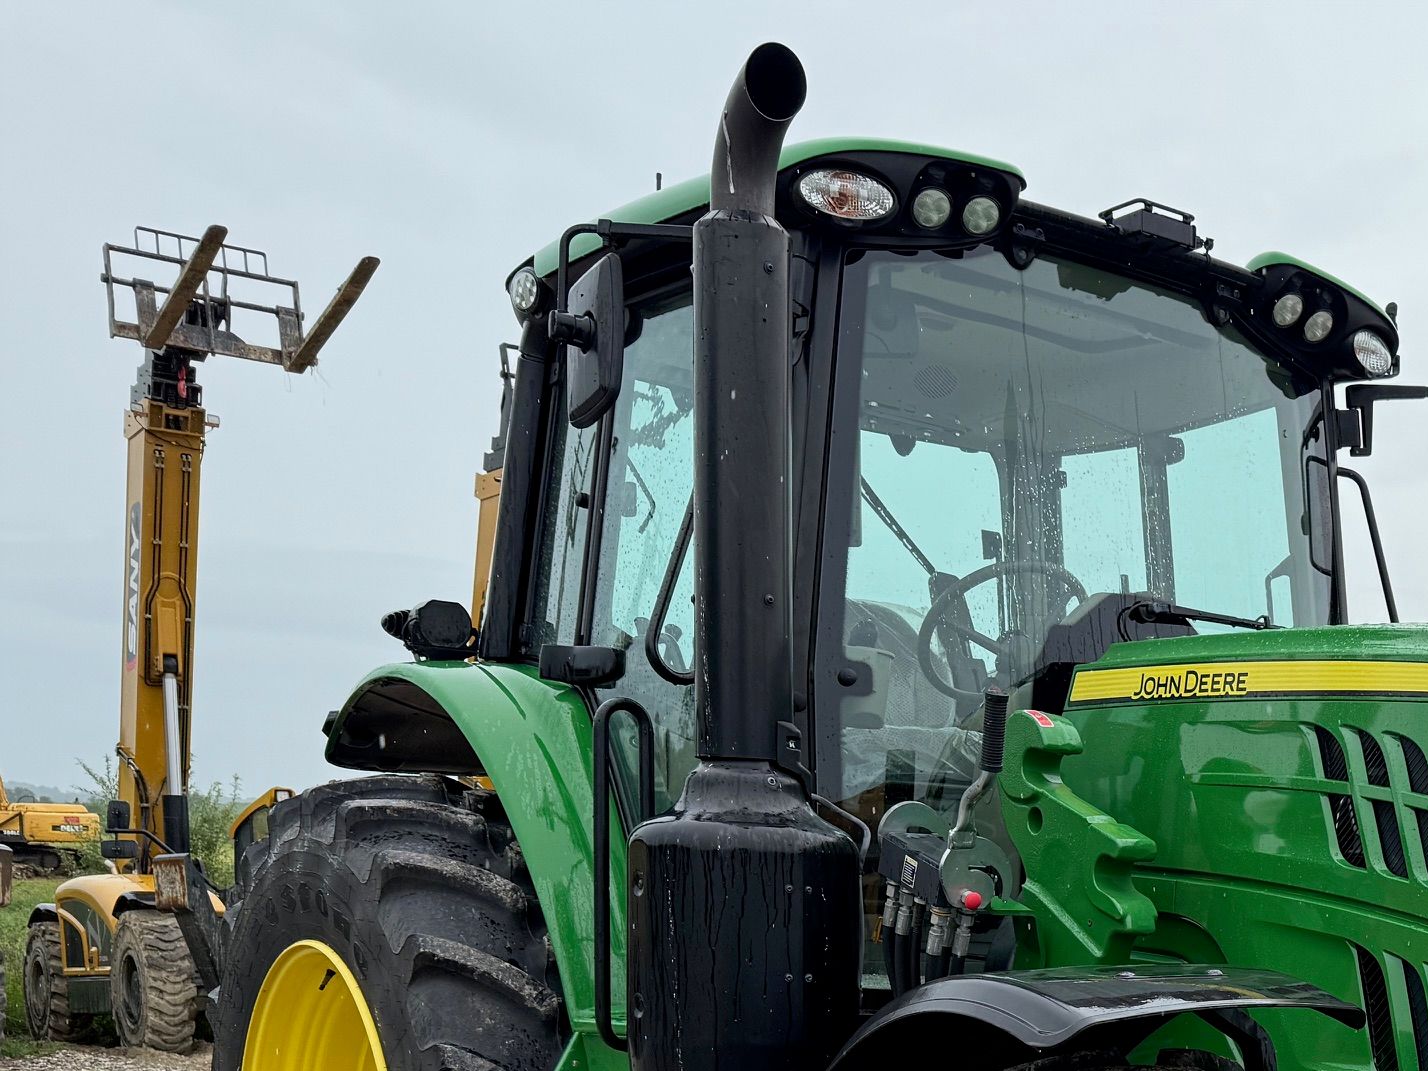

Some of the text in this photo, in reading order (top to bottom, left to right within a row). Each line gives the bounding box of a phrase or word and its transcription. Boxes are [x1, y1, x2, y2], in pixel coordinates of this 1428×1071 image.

[127, 522, 140, 656] SANY
[1132, 670, 1249, 697] JOHN DEERE
